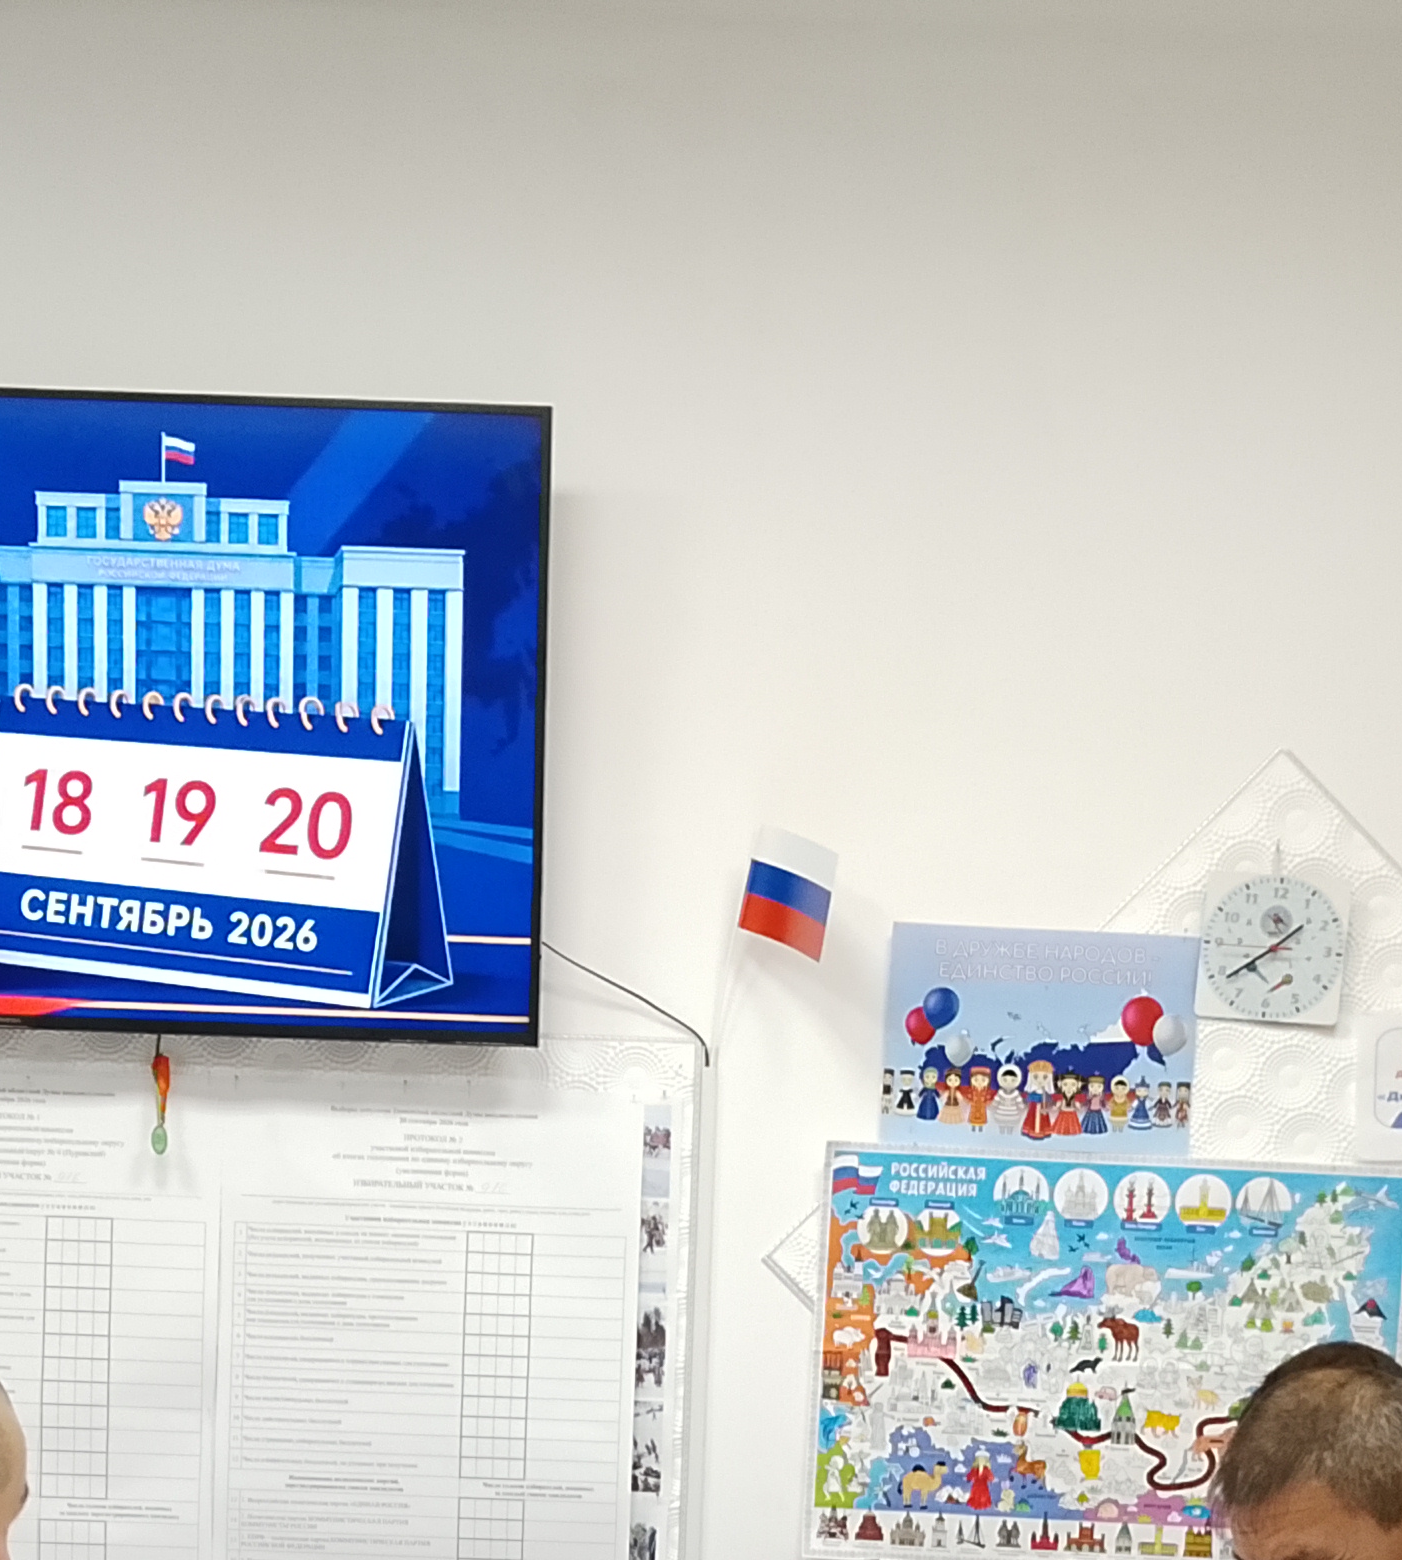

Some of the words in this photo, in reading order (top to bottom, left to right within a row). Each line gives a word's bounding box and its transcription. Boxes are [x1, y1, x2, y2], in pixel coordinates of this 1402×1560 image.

[87, 556, 203, 570] ГОСУДАРСТВЕННАЯ
[206, 560, 240, 572] ДУМА
[24, 768, 93, 835] 18
[143, 778, 217, 846] 19
[259, 787, 353, 860] 20
[1245, 893, 1258, 904] 11
[1274, 887, 1289, 899] 12
[20, 888, 214, 940] СЕНТЯБРЬ
[227, 911, 318, 952] 2026
[1224, 912, 1240, 923] 10
[1319, 920, 1329, 932] 2
[936, 940, 947, 955] В
[953, 941, 1037, 959] ДРУЖБЕ
[1045, 944, 1146, 965] НАРОДОВ
[1323, 946, 1332, 958] 3
[939, 962, 1053, 981] ЕДИНСТВО
[1060, 967, 1152, 986] РОССИИ!
[1235, 987, 1244, 999] 7
[1291, 993, 1300, 1005] 5
[1261, 998, 1271, 1009] 6
[890, 1161, 986, 1181] РОССИЙСКАЯ
[424, 1182, 464, 1191] УЧАСТОК
[889, 1179, 978, 1198] ФЕДЕРАЦИЯ
